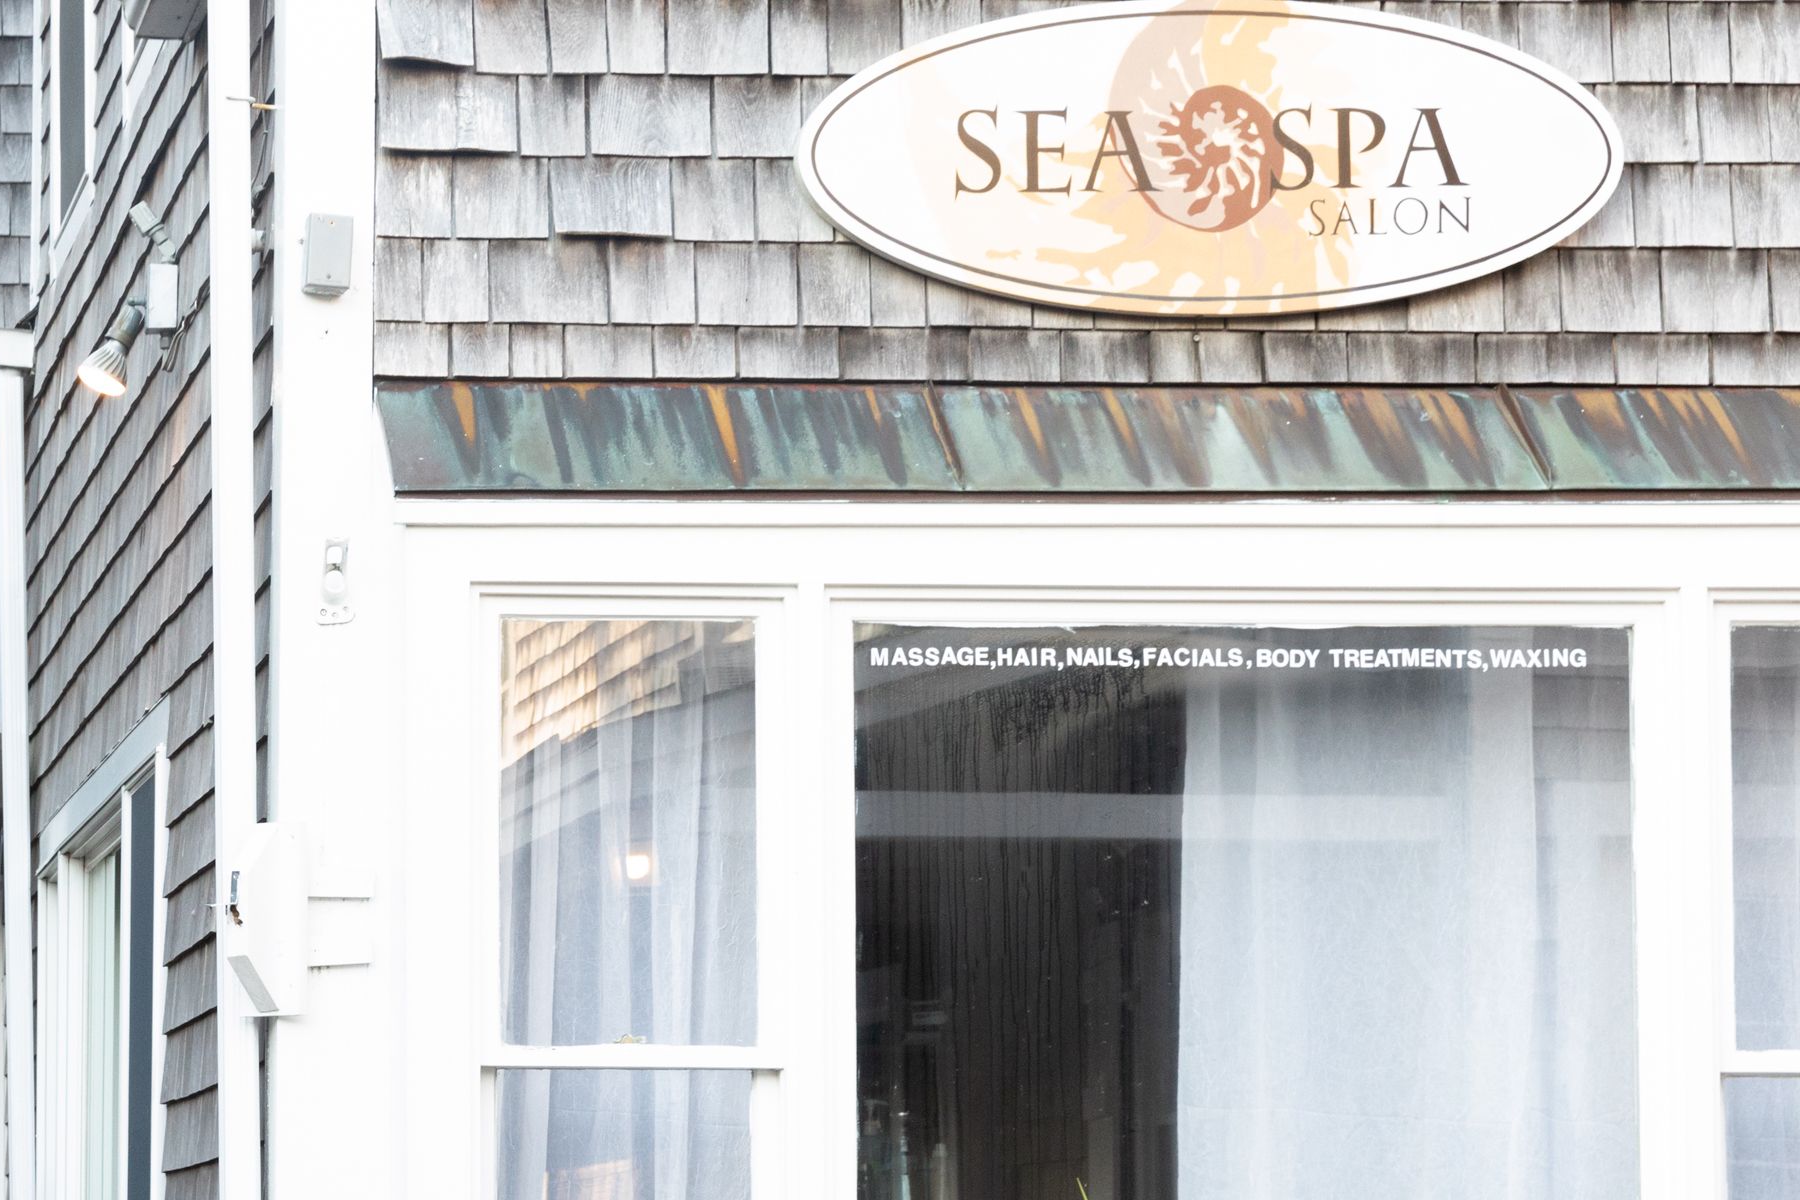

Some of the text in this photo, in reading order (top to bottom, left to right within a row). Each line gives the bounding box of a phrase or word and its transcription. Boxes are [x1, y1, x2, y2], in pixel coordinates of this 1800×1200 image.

[954, 103, 1471, 200] SEA SPA
[1309, 196, 1472, 237] SALON
